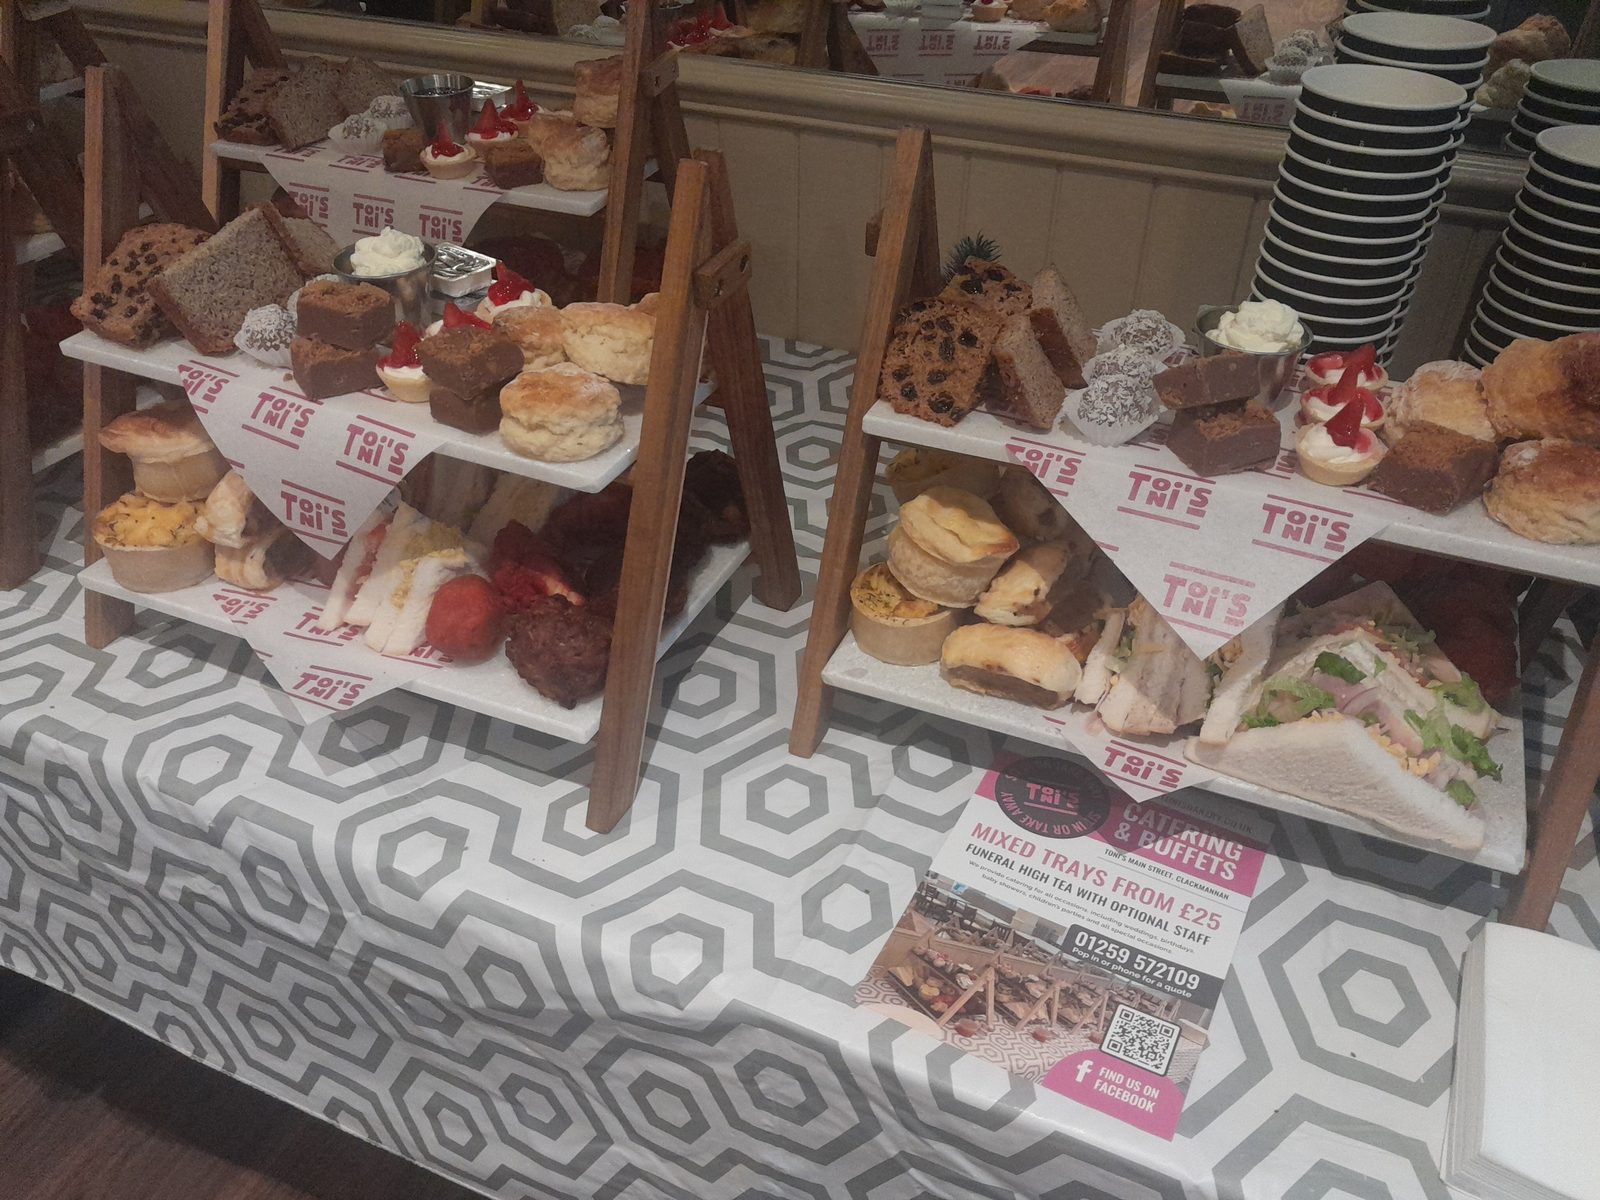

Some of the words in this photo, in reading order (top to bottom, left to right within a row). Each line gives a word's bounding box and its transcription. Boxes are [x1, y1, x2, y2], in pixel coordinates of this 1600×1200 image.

[1000, 791, 1023, 816] AWAY
[1021, 815, 1049, 834] TAKE
[1053, 824, 1071, 835] OR
[1071, 820, 1088, 833] IN
[1114, 822, 1131, 842] &
[1138, 829, 1237, 880] BUFFETS
[1123, 802, 1244, 861] CATERING
[965, 842, 1016, 871] FUNERAL
[1018, 863, 1050, 885] HIGH
[1051, 876, 1073, 894] TEA
[1076, 886, 1108, 908] WITH
[1110, 898, 1170, 934] OPTIONAL
[1174, 924, 1211, 947] STAFF
[969, 860, 979, 868] We
[979, 865, 1005, 878] provide
[1006, 875, 1034, 891] catering
[1090, 909, 1123, 927] including
[970, 823, 1036, 859] MIXED
[1043, 848, 1105, 888] TRAYS
[1111, 876, 1174, 913] FROM
[1178, 902, 1223, 931] £25
[1104, 848, 1127, 861] TONI'S
[1128, 857, 1146, 869] MAIN
[1175, 875, 1229, 900] CLACKMANNAN
[981, 873, 998, 884] baby
[1028, 893, 1060, 910] children's
[1061, 907, 1085, 921] parties
[1087, 917, 1100, 926] and
[1101, 922, 1110, 930] all
[1111, 926, 1136, 940] special
[1072, 946, 1090, 959] Pop
[1090, 953, 1100, 963] in
[1100, 959, 1111, 967] or
[1111, 963, 1142, 979] phone
[1142, 974, 1156, 985] for
[1164, 984, 1193, 998] quote
[1074, 931, 1131, 964] 01259
[1133, 954, 1200, 990] 572109
[1093, 1079, 1156, 1113] FACEBOOK
[1099, 1067, 1125, 1085] FIND
[1125, 1077, 1142, 1092] US
[1143, 1085, 1160, 1099] ON
